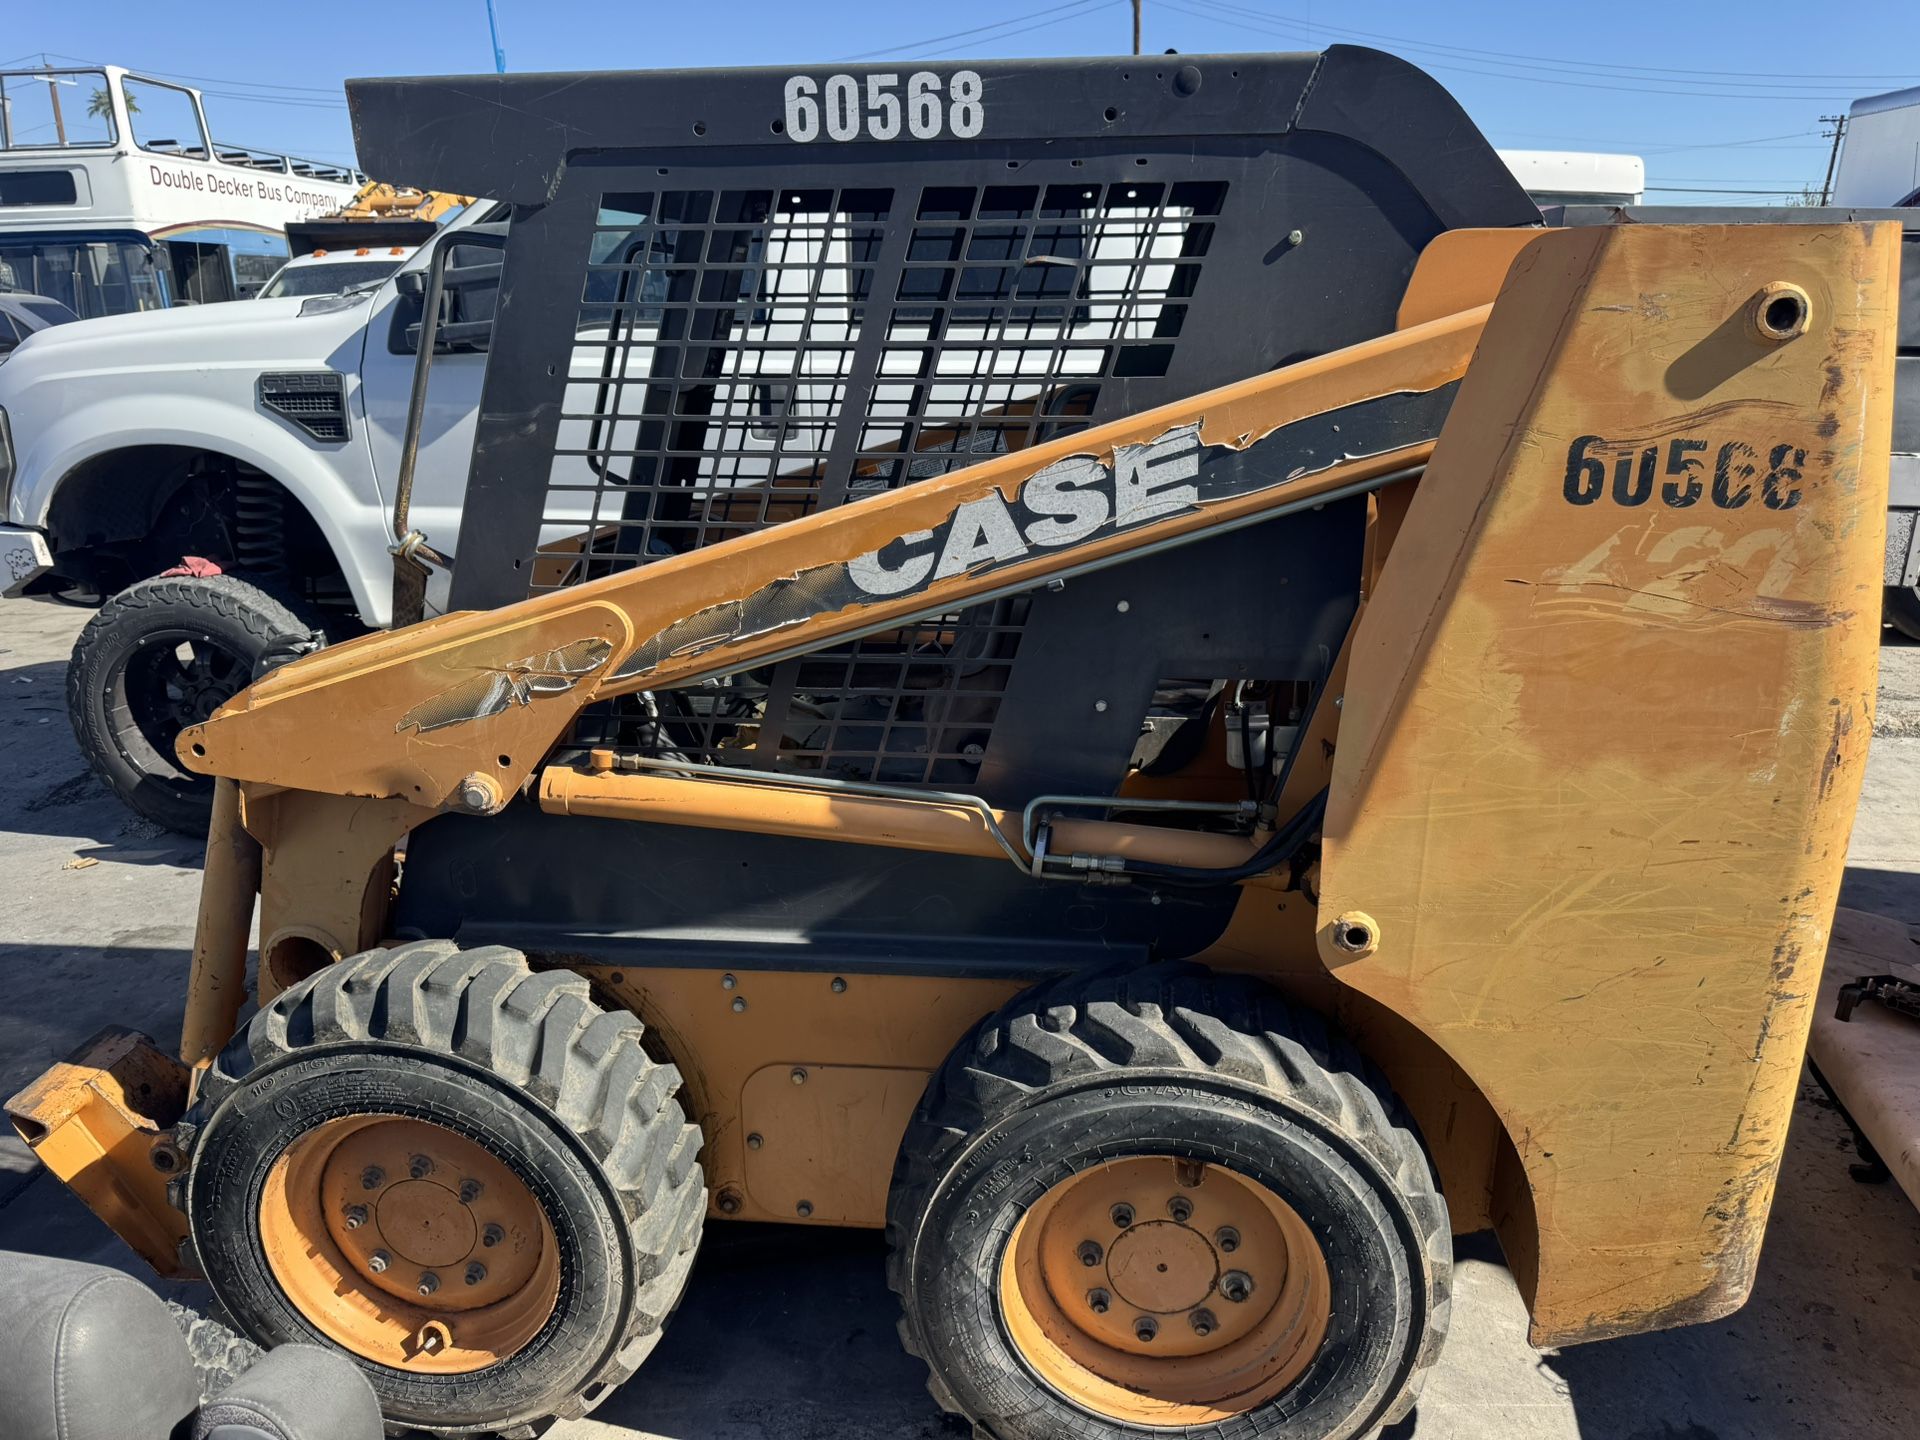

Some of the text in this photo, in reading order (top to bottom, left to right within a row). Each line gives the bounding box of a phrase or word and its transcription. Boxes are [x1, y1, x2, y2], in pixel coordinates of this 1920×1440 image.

[784, 70, 984, 143] 60568
[150, 165, 337, 209] Double Decker Bus Company
[847, 421, 1199, 595] CASE
[1562, 434, 1809, 510] 60568
